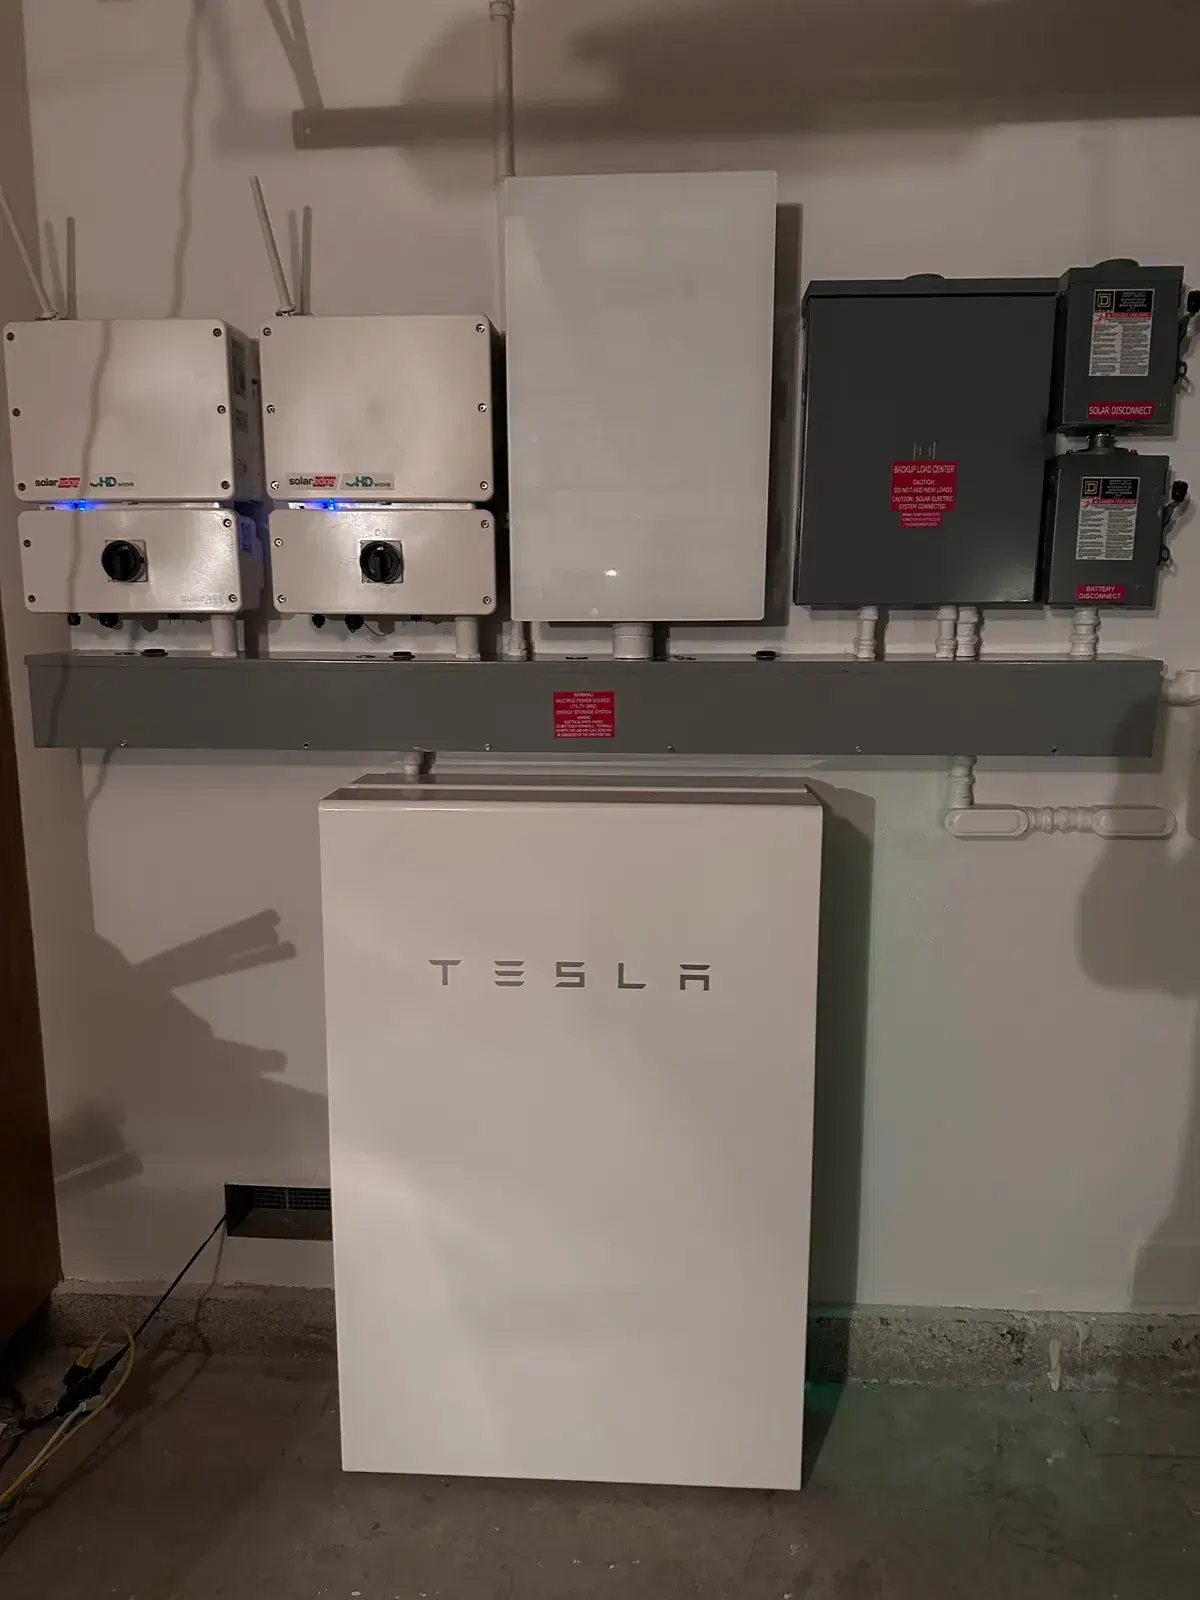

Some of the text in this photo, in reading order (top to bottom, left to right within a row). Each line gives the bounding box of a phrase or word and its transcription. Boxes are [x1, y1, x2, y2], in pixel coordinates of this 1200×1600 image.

[1089, 406, 1153, 415] SOLAR DISCONNECT
[894, 465, 955, 474] BACKUP LOAD CENTER
[35, 477, 80, 488] solaredge
[99, 476, 117, 487] HD
[289, 476, 336, 487] solaredge
[355, 476, 373, 487] HD
[1086, 585, 1116, 593] BATTERY
[1079, 592, 1122, 600] DISCONNECT
[428, 959, 711, 991] TESLA
